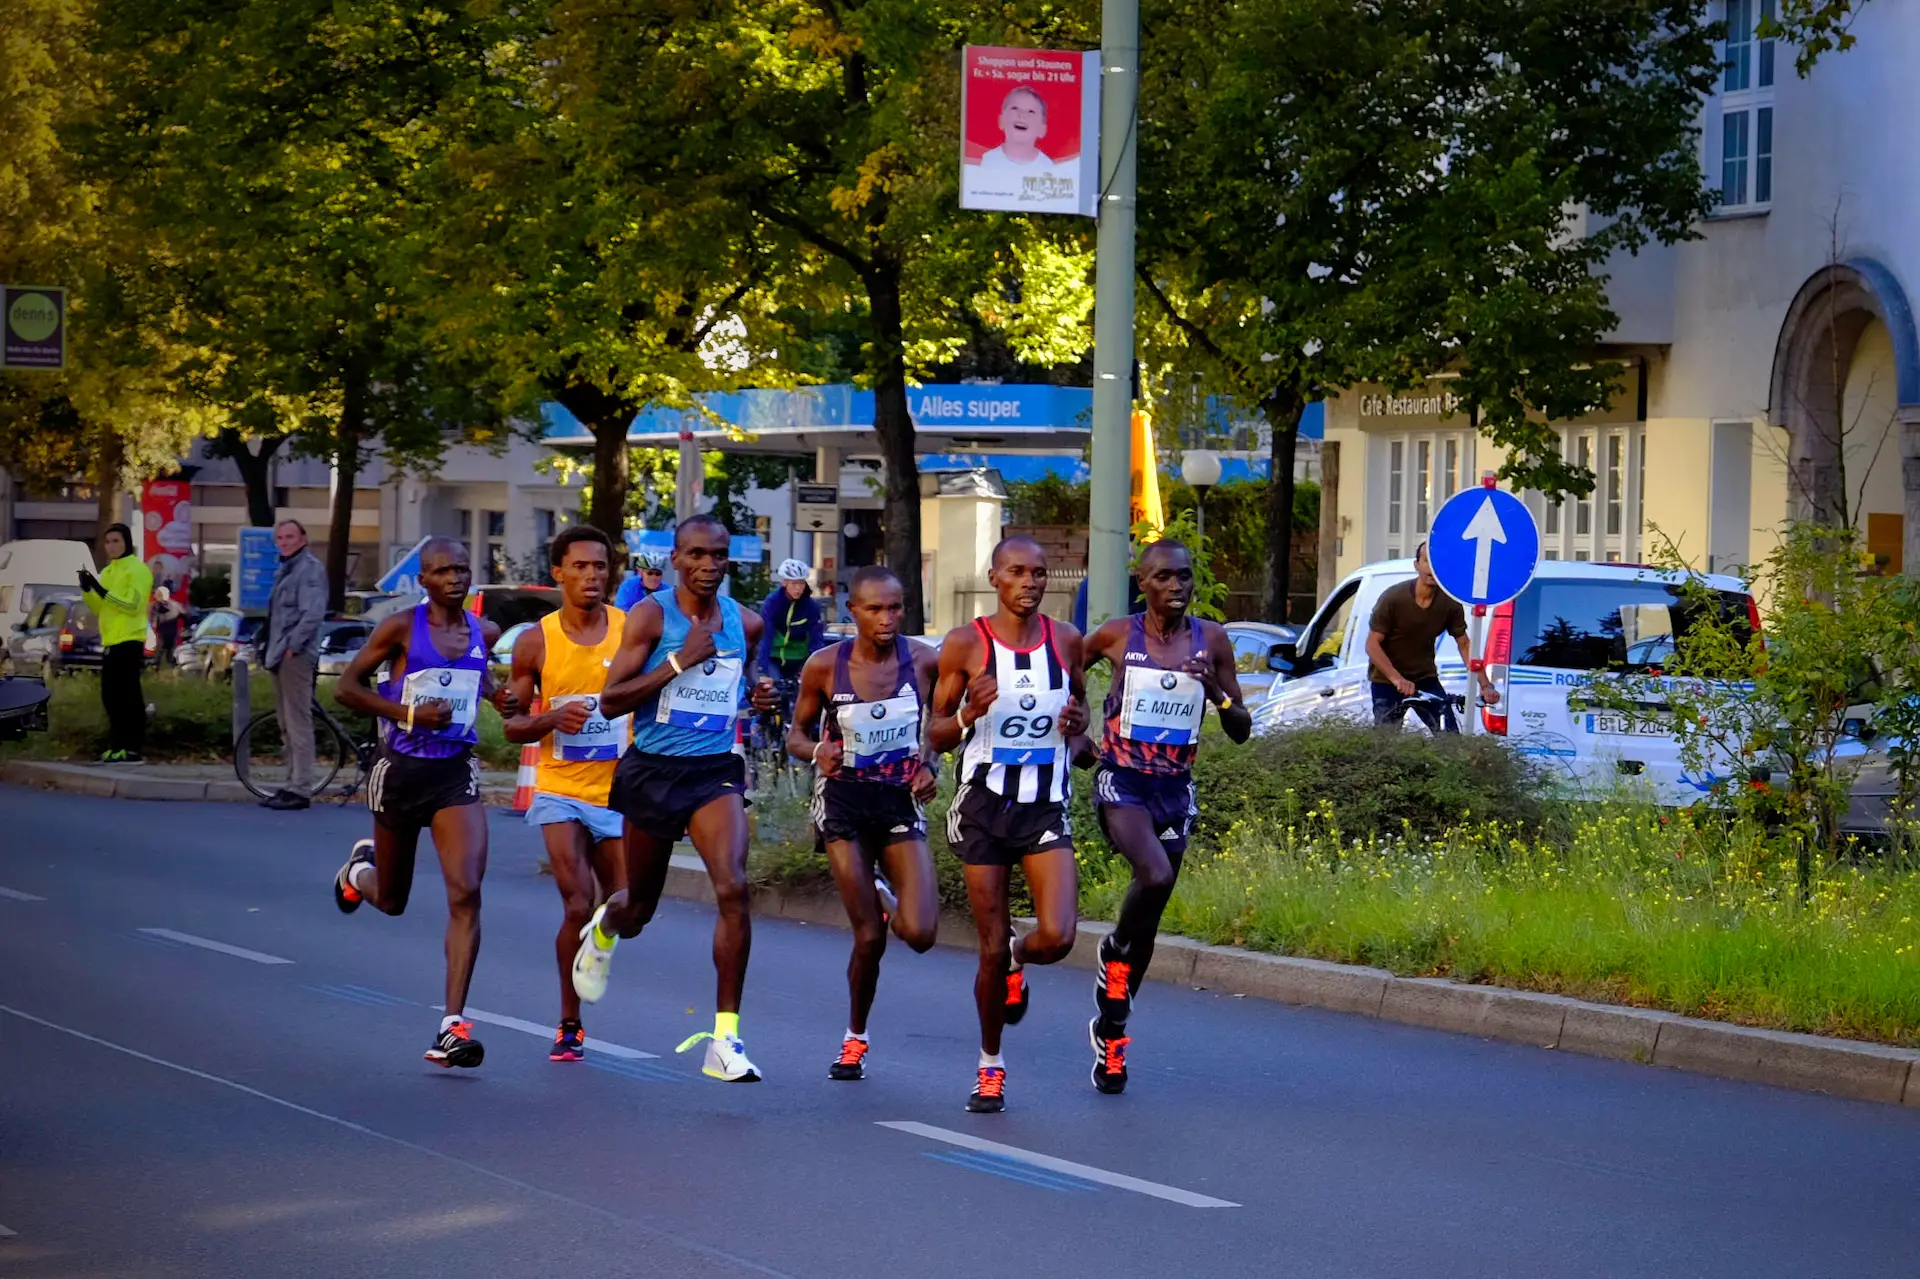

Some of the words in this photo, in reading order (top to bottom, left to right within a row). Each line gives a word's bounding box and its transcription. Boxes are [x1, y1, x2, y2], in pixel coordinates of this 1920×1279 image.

[978, 56, 1016, 69] Shoppen
[1017, 58, 1034, 68] und
[1036, 59, 1072, 70] Staunen
[992, 69, 1005, 79] Sa.
[1007, 71, 1030, 83] sogar
[1032, 70, 1045, 81] bis
[1047, 71, 1058, 82] 21
[1060, 72, 1076, 83] Uhr
[920, 395, 963, 417] Alles
[968, 400, 1021, 421] super.
[1386, 394, 1442, 416] Restaurant
[1125, 651, 1148, 662] AKTIV
[676, 687, 730, 703] KIPCHOGE
[832, 693, 855, 702] AKTIV
[1135, 698, 1146, 712] E.
[1151, 700, 1195, 717] MUTAI
[1000, 715, 1052, 738] 69
[854, 732, 865, 744] G.
